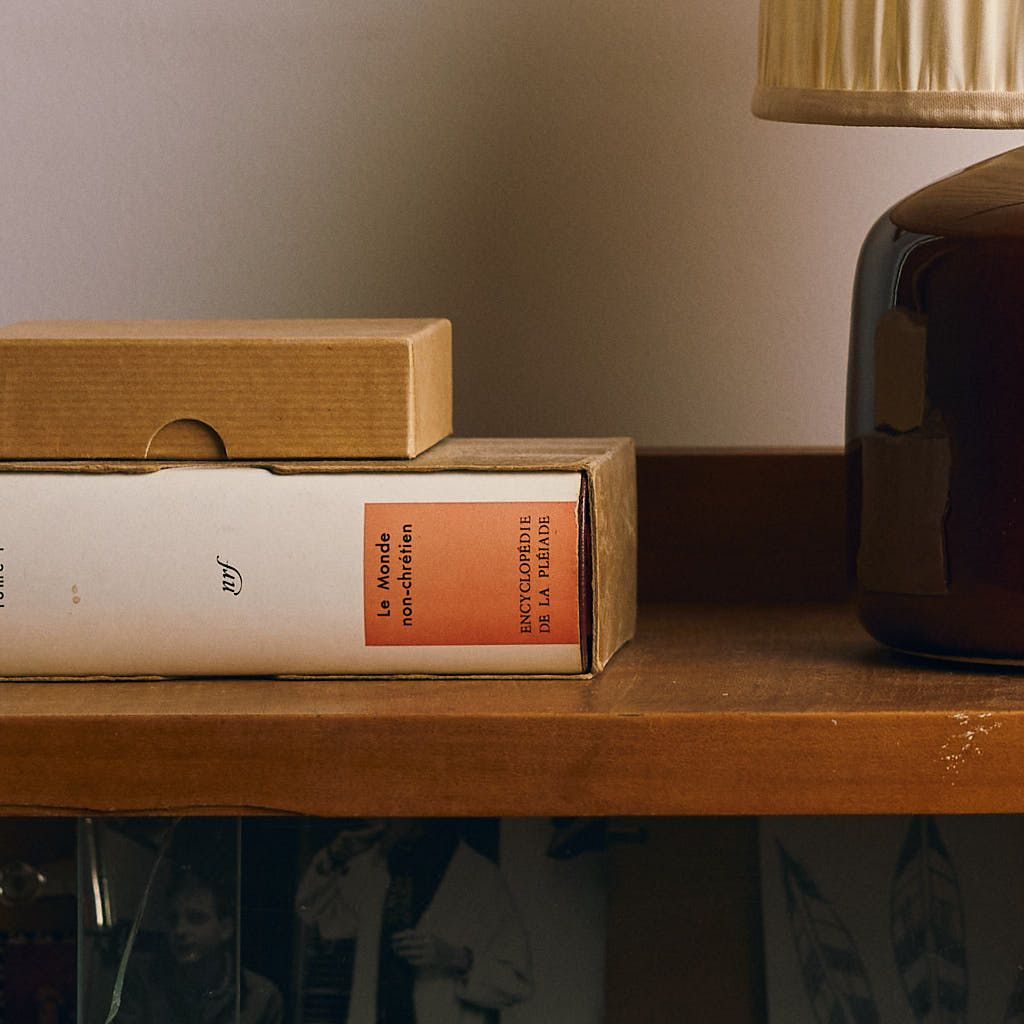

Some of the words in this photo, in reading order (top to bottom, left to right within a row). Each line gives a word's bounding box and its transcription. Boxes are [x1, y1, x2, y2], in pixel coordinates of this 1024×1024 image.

[375, 532, 391, 590] Monde
[535, 515, 550, 578] PLÉIADE
[216, 555, 243, 596] nrf
[396, 523, 413, 627] non-chrétien
[516, 515, 532, 634] ENCYCLOPÉDIE
[538, 587, 550, 607] LA
[376, 599, 391, 617] Le
[538, 614, 551, 634] DE
